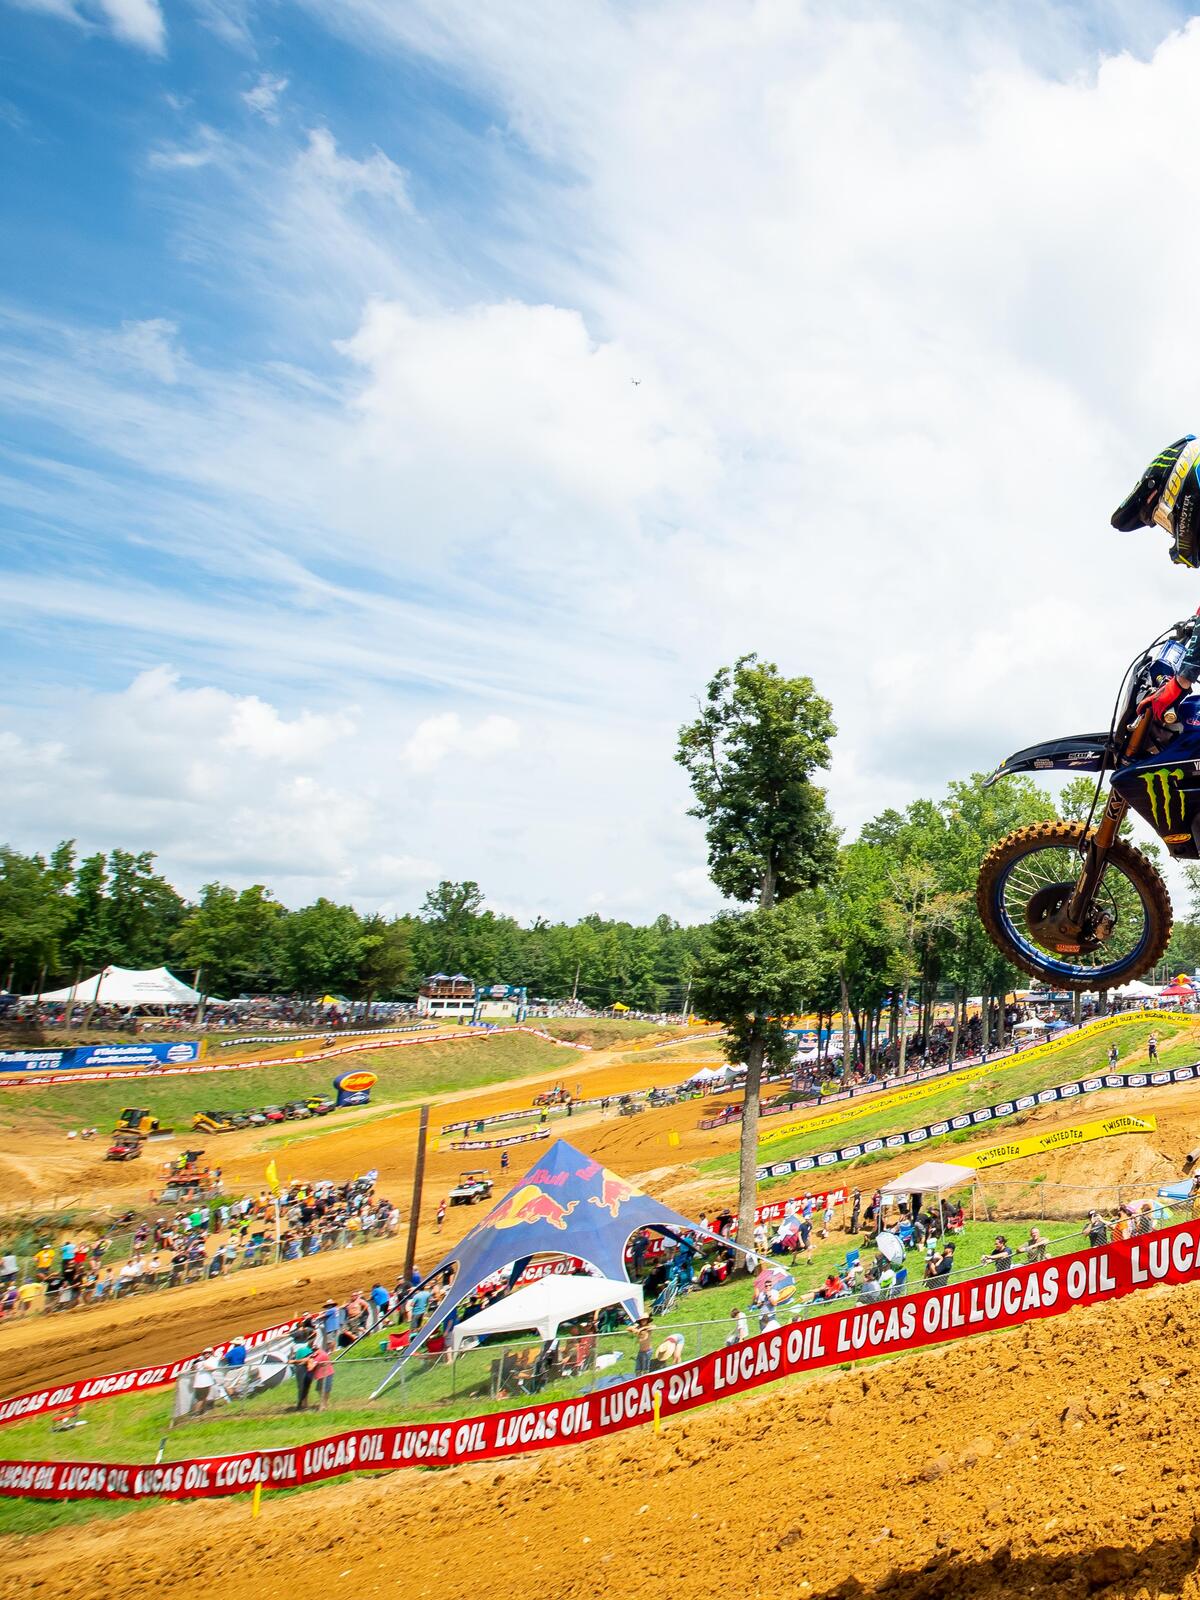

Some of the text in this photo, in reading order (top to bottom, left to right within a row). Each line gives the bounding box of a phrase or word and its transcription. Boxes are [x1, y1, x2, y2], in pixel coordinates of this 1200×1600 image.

[1039, 1129, 1083, 1148] TWISTED TEA
[1102, 1117, 1132, 1133] TWISTED
[976, 1146, 1020, 1164] TWISTED TEA
[968, 1253, 1117, 1324] LUCAS OIL
[836, 1292, 965, 1353] LUCAS OIL
[714, 1324, 825, 1390] LUCAS OIL
[47, 1385, 76, 1406] OIL
[79, 1366, 166, 1400] LUCAS OIL
[600, 1365, 704, 1427] LUCAS OIL
[391, 1421, 487, 1461] LUCAS OIL
[495, 1401, 593, 1448] LUCAS OIL
[215, 1453, 297, 1487] LUCAS OIL
[303, 1434, 385, 1475] LUCAS OIL
